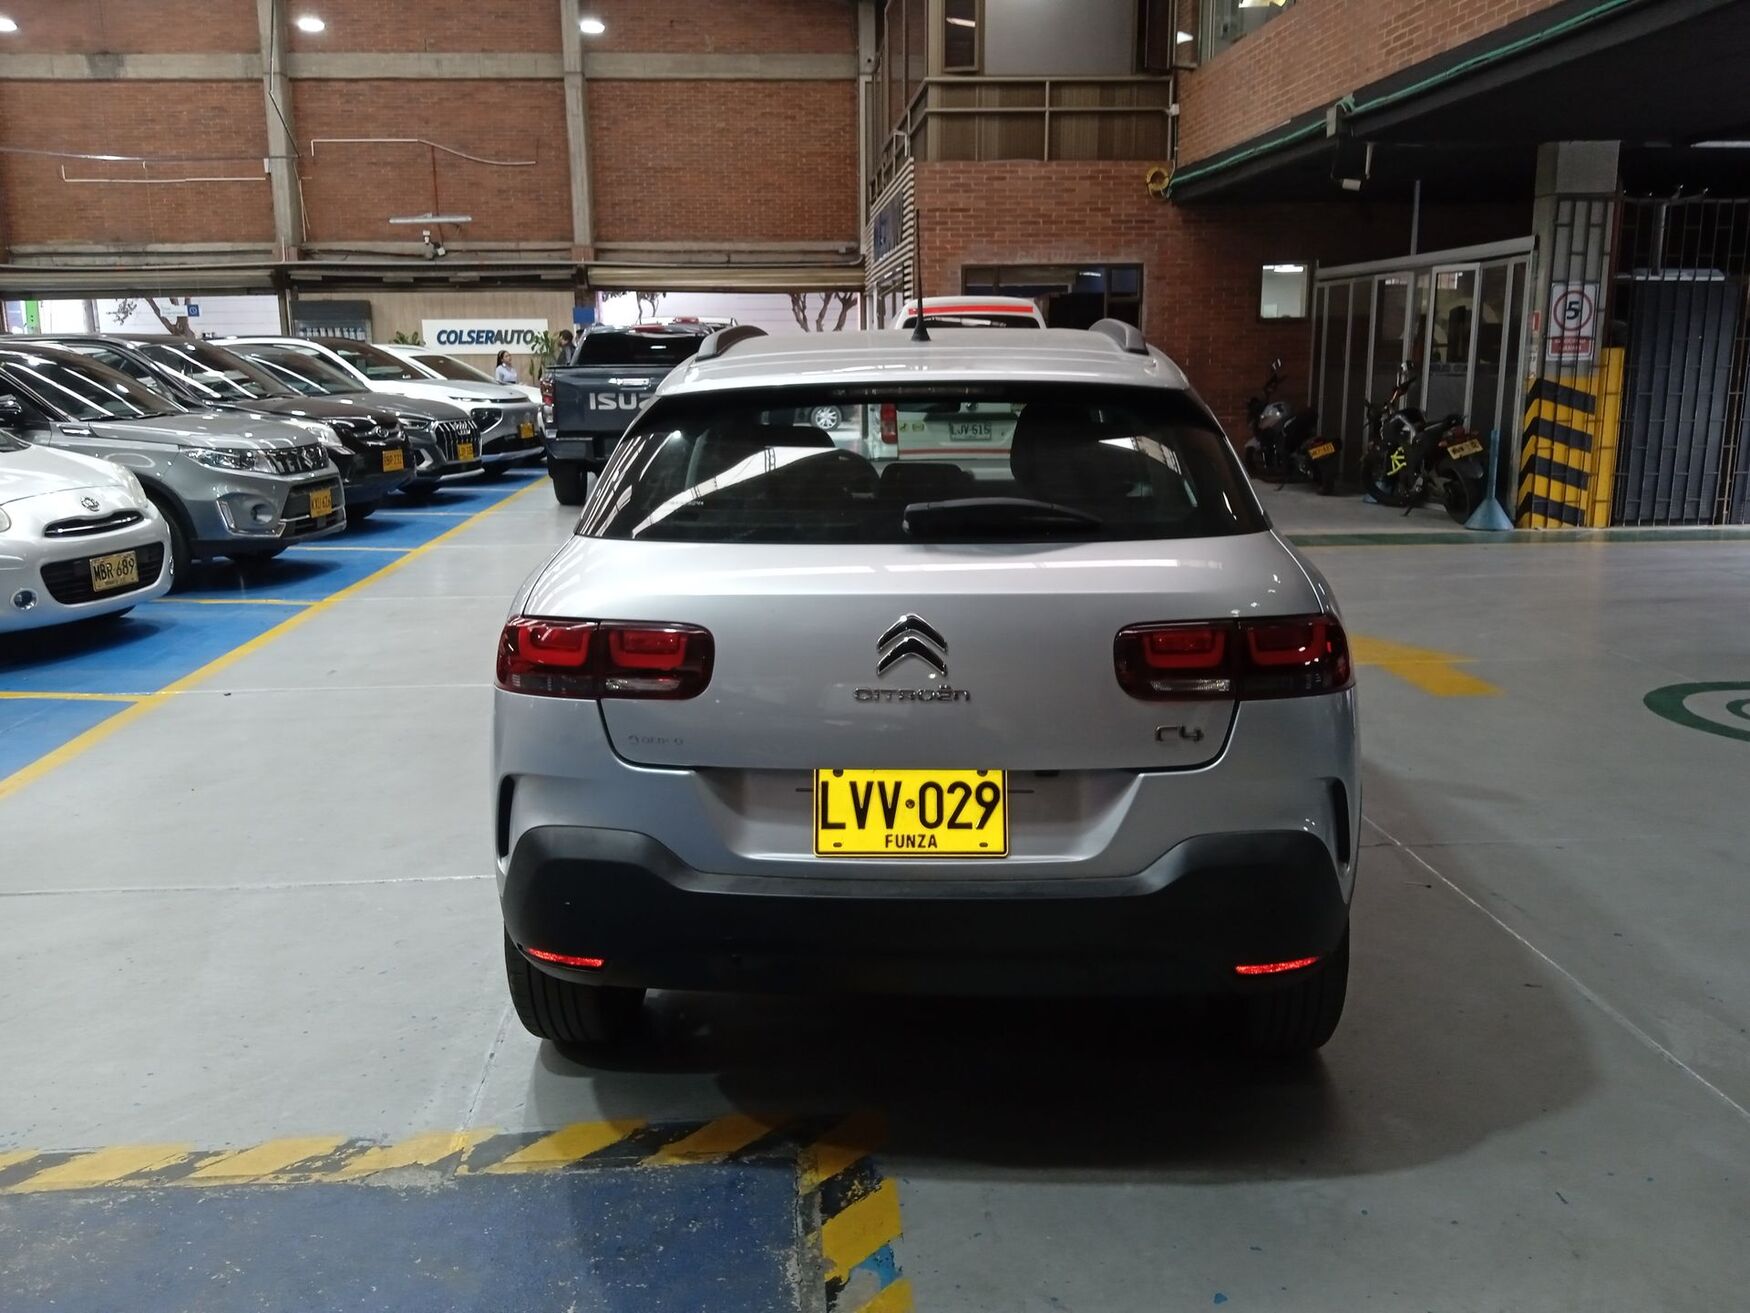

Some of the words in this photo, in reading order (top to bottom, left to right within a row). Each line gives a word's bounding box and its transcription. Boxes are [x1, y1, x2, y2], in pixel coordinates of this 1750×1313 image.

[1566, 300, 1580, 320] 5
[436, 328, 536, 345] COLSERAUTO
[884, 833, 938, 849] FUNZA
